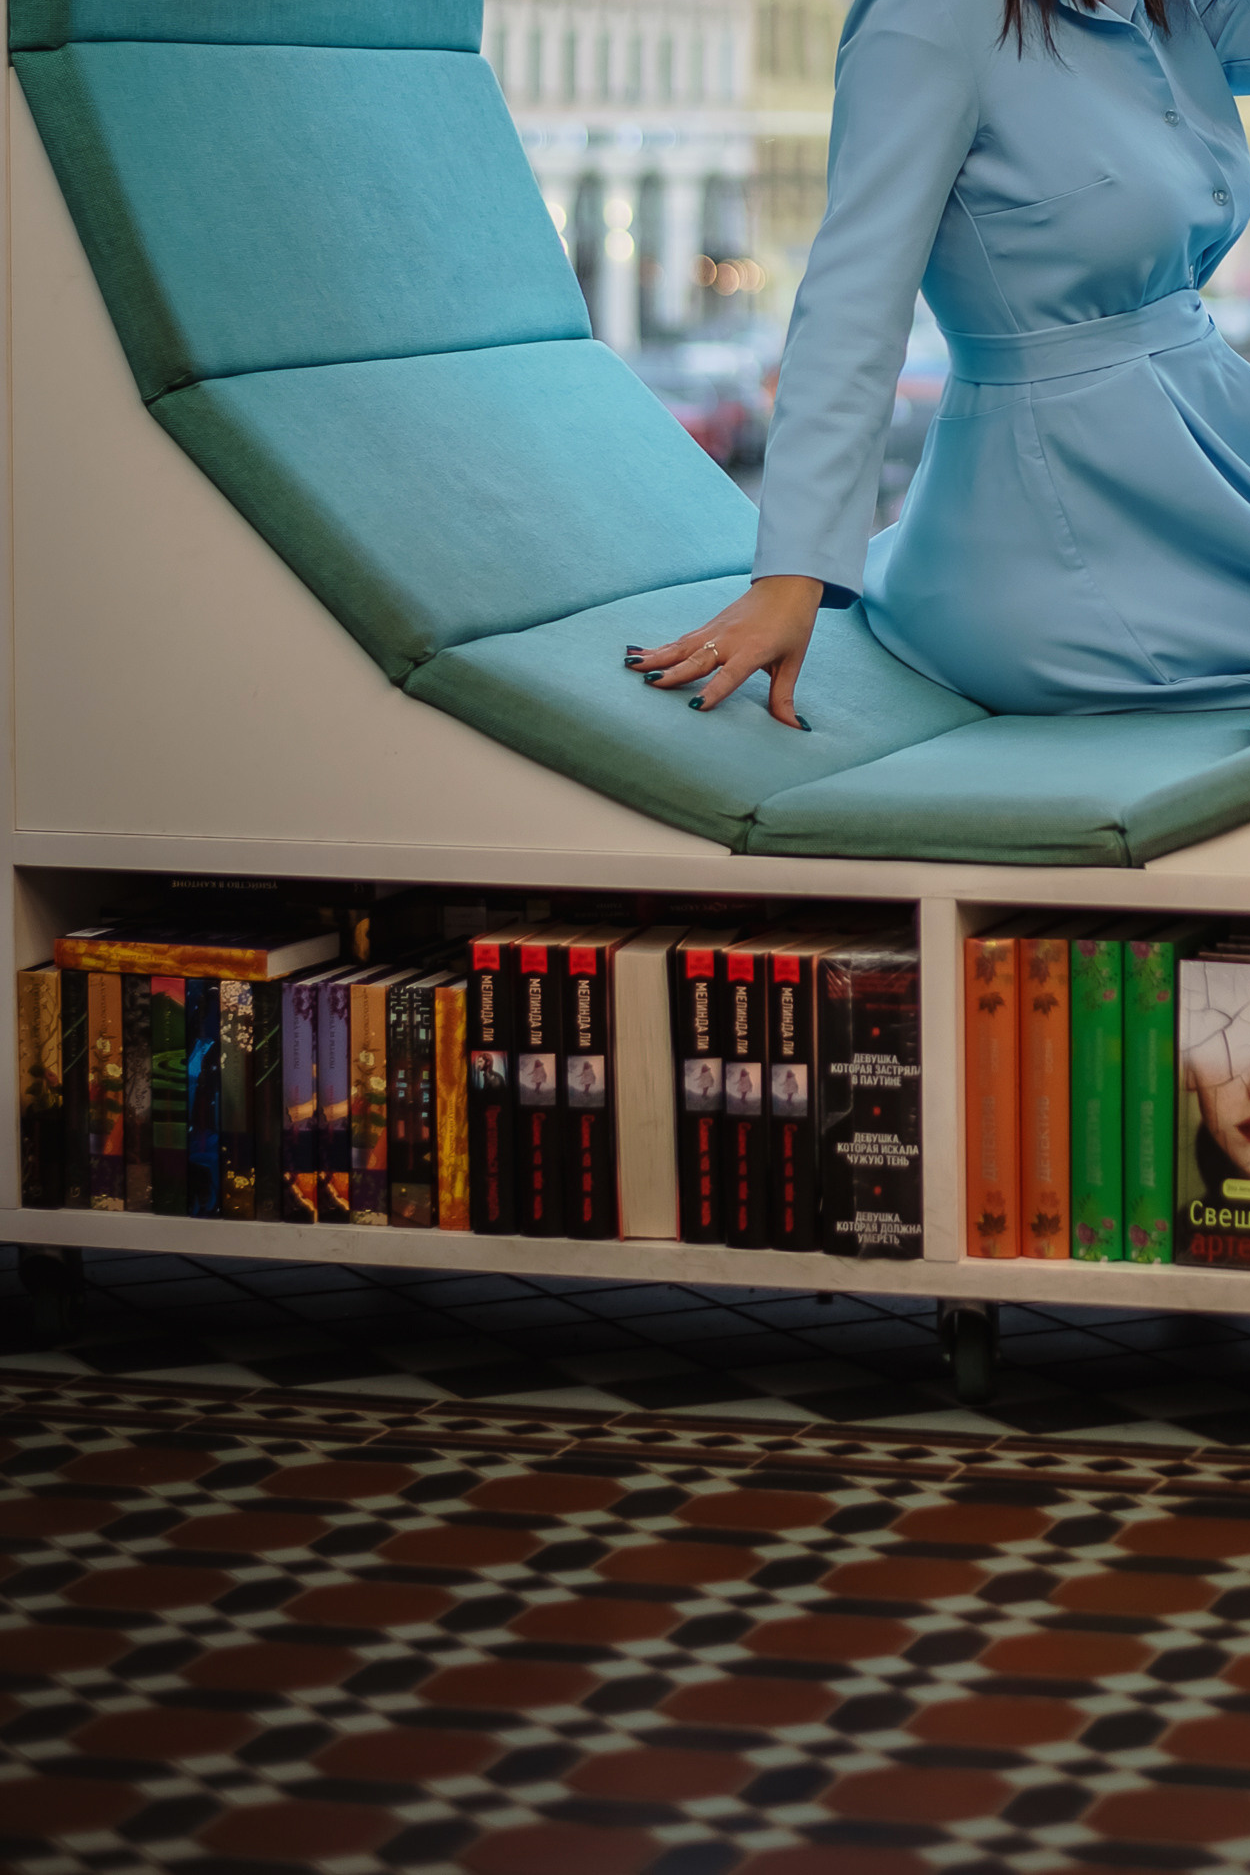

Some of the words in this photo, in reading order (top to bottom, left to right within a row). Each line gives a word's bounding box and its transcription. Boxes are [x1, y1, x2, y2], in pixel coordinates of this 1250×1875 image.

[480, 975, 494, 1026] МЕЛИНДА
[529, 978, 542, 1029] МЕЛИНДА
[578, 980, 591, 1030] МЕЛИНДА
[695, 982, 708, 1033] МЕЛИНДА
[735, 986, 748, 1036] МЕЛИНДА
[781, 987, 794, 1037] МЕЛИНДА
[482, 1027, 494, 1042] ЛИ
[530, 1030, 542, 1045] ЛИ
[580, 1032, 592, 1047] ЛИ
[697, 1035, 709, 1049] ЛИ
[736, 1038, 749, 1054] ЛИ
[782, 1039, 795, 1055] ЛИ
[853, 1053, 900, 1065] ДЕВУШКА,
[830, 1063, 872, 1075] КОТОРАЯ
[851, 1075, 858, 1085] В
[860, 1075, 902, 1087] ПАУТИНЕ
[853, 1132, 901, 1145] ДЕВУШКА,
[837, 1142, 880, 1155] КОТОРАЯ
[881, 1144, 919, 1156] ИСКАЛА
[847, 1154, 884, 1165] ЧУЖУЮ
[886, 1154, 910, 1166] ТЕНЬ
[836, 1221, 878, 1234] КОТОРАЯ
[880, 1222, 922, 1234] ДОЛЖНА
[857, 1232, 900, 1245] УМЕРЕТЬ
